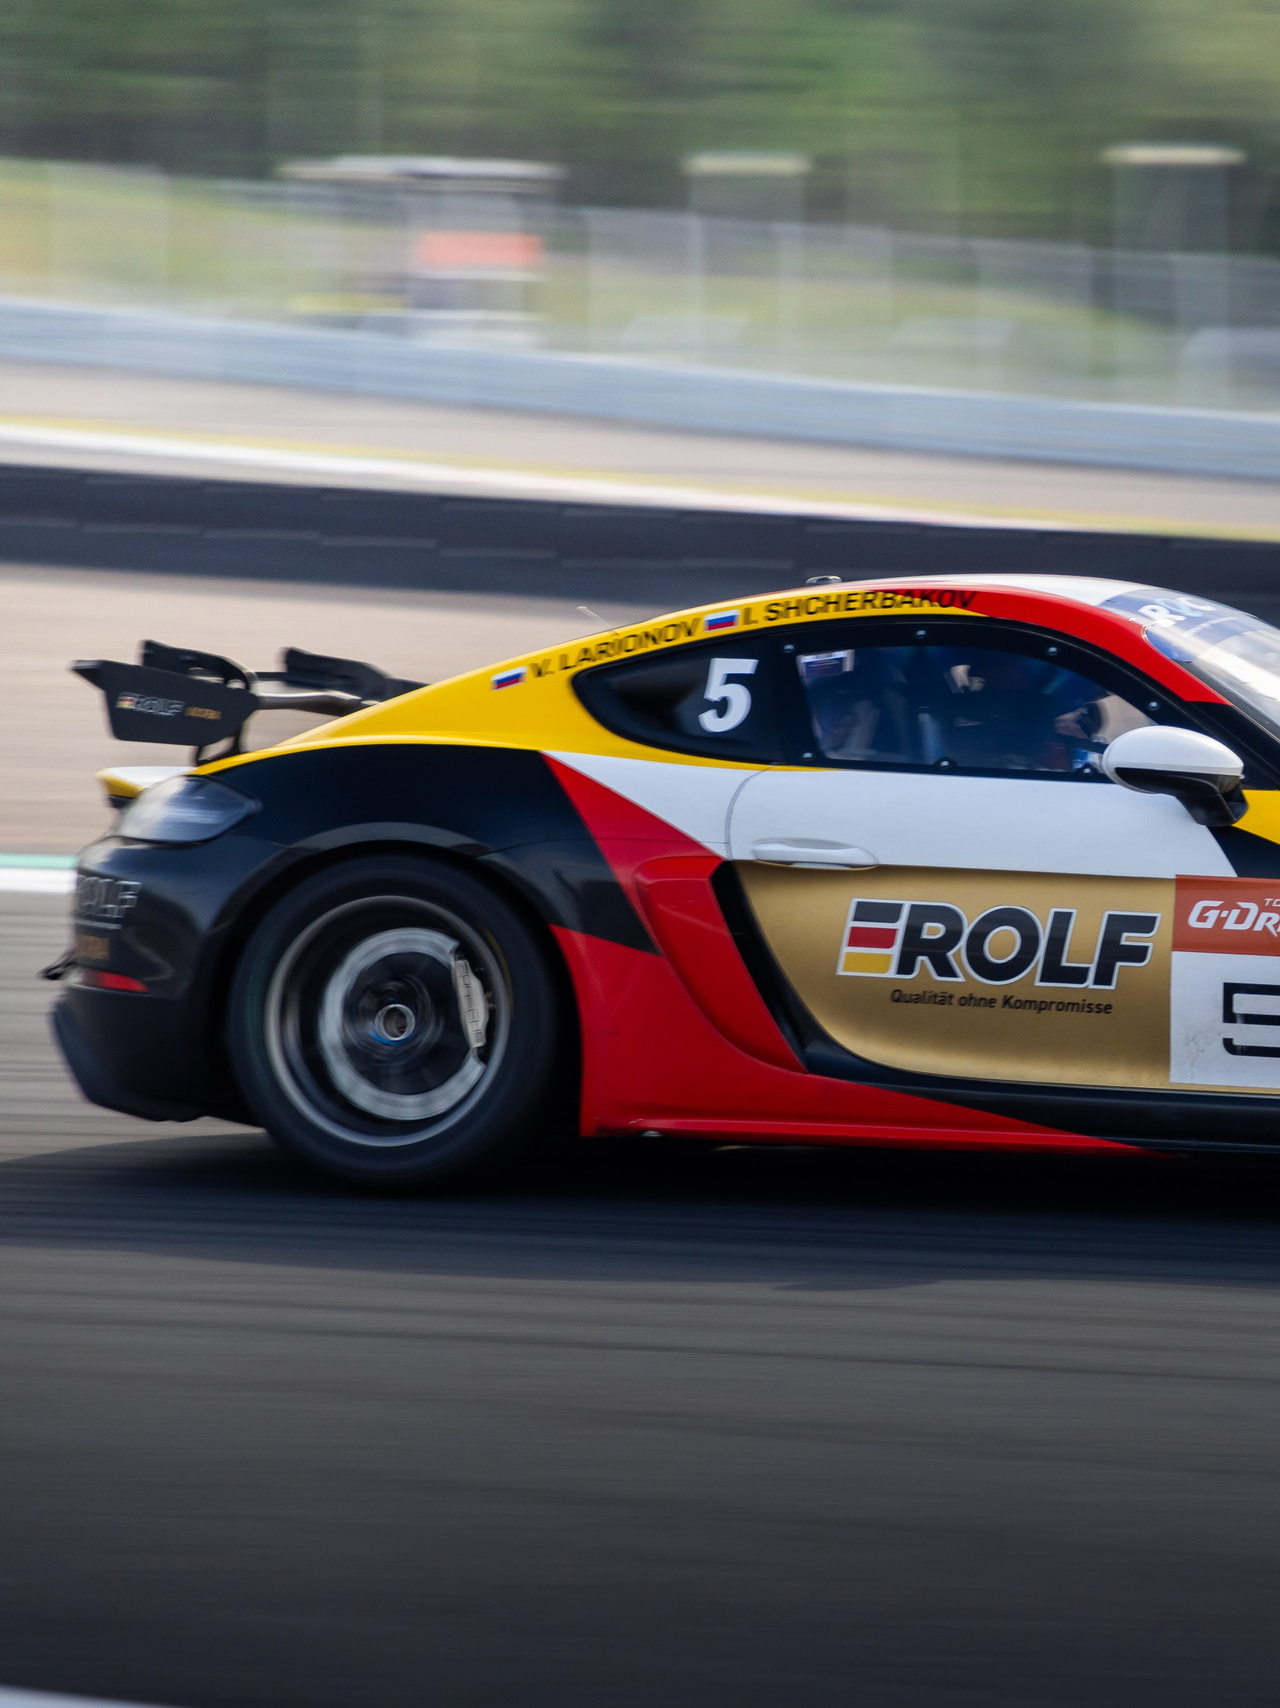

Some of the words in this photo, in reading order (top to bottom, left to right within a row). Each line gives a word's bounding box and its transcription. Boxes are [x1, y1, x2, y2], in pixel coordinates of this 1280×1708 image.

[765, 590, 977, 621] SHCHERBAKOV
[559, 617, 701, 671] LARIONOV
[698, 658, 758, 732] 5
[896, 900, 1162, 989] ROLF
[890, 989, 954, 1007] Qualität
[958, 993, 997, 1008] ohne
[1001, 994, 1113, 1015] Kompromisse
